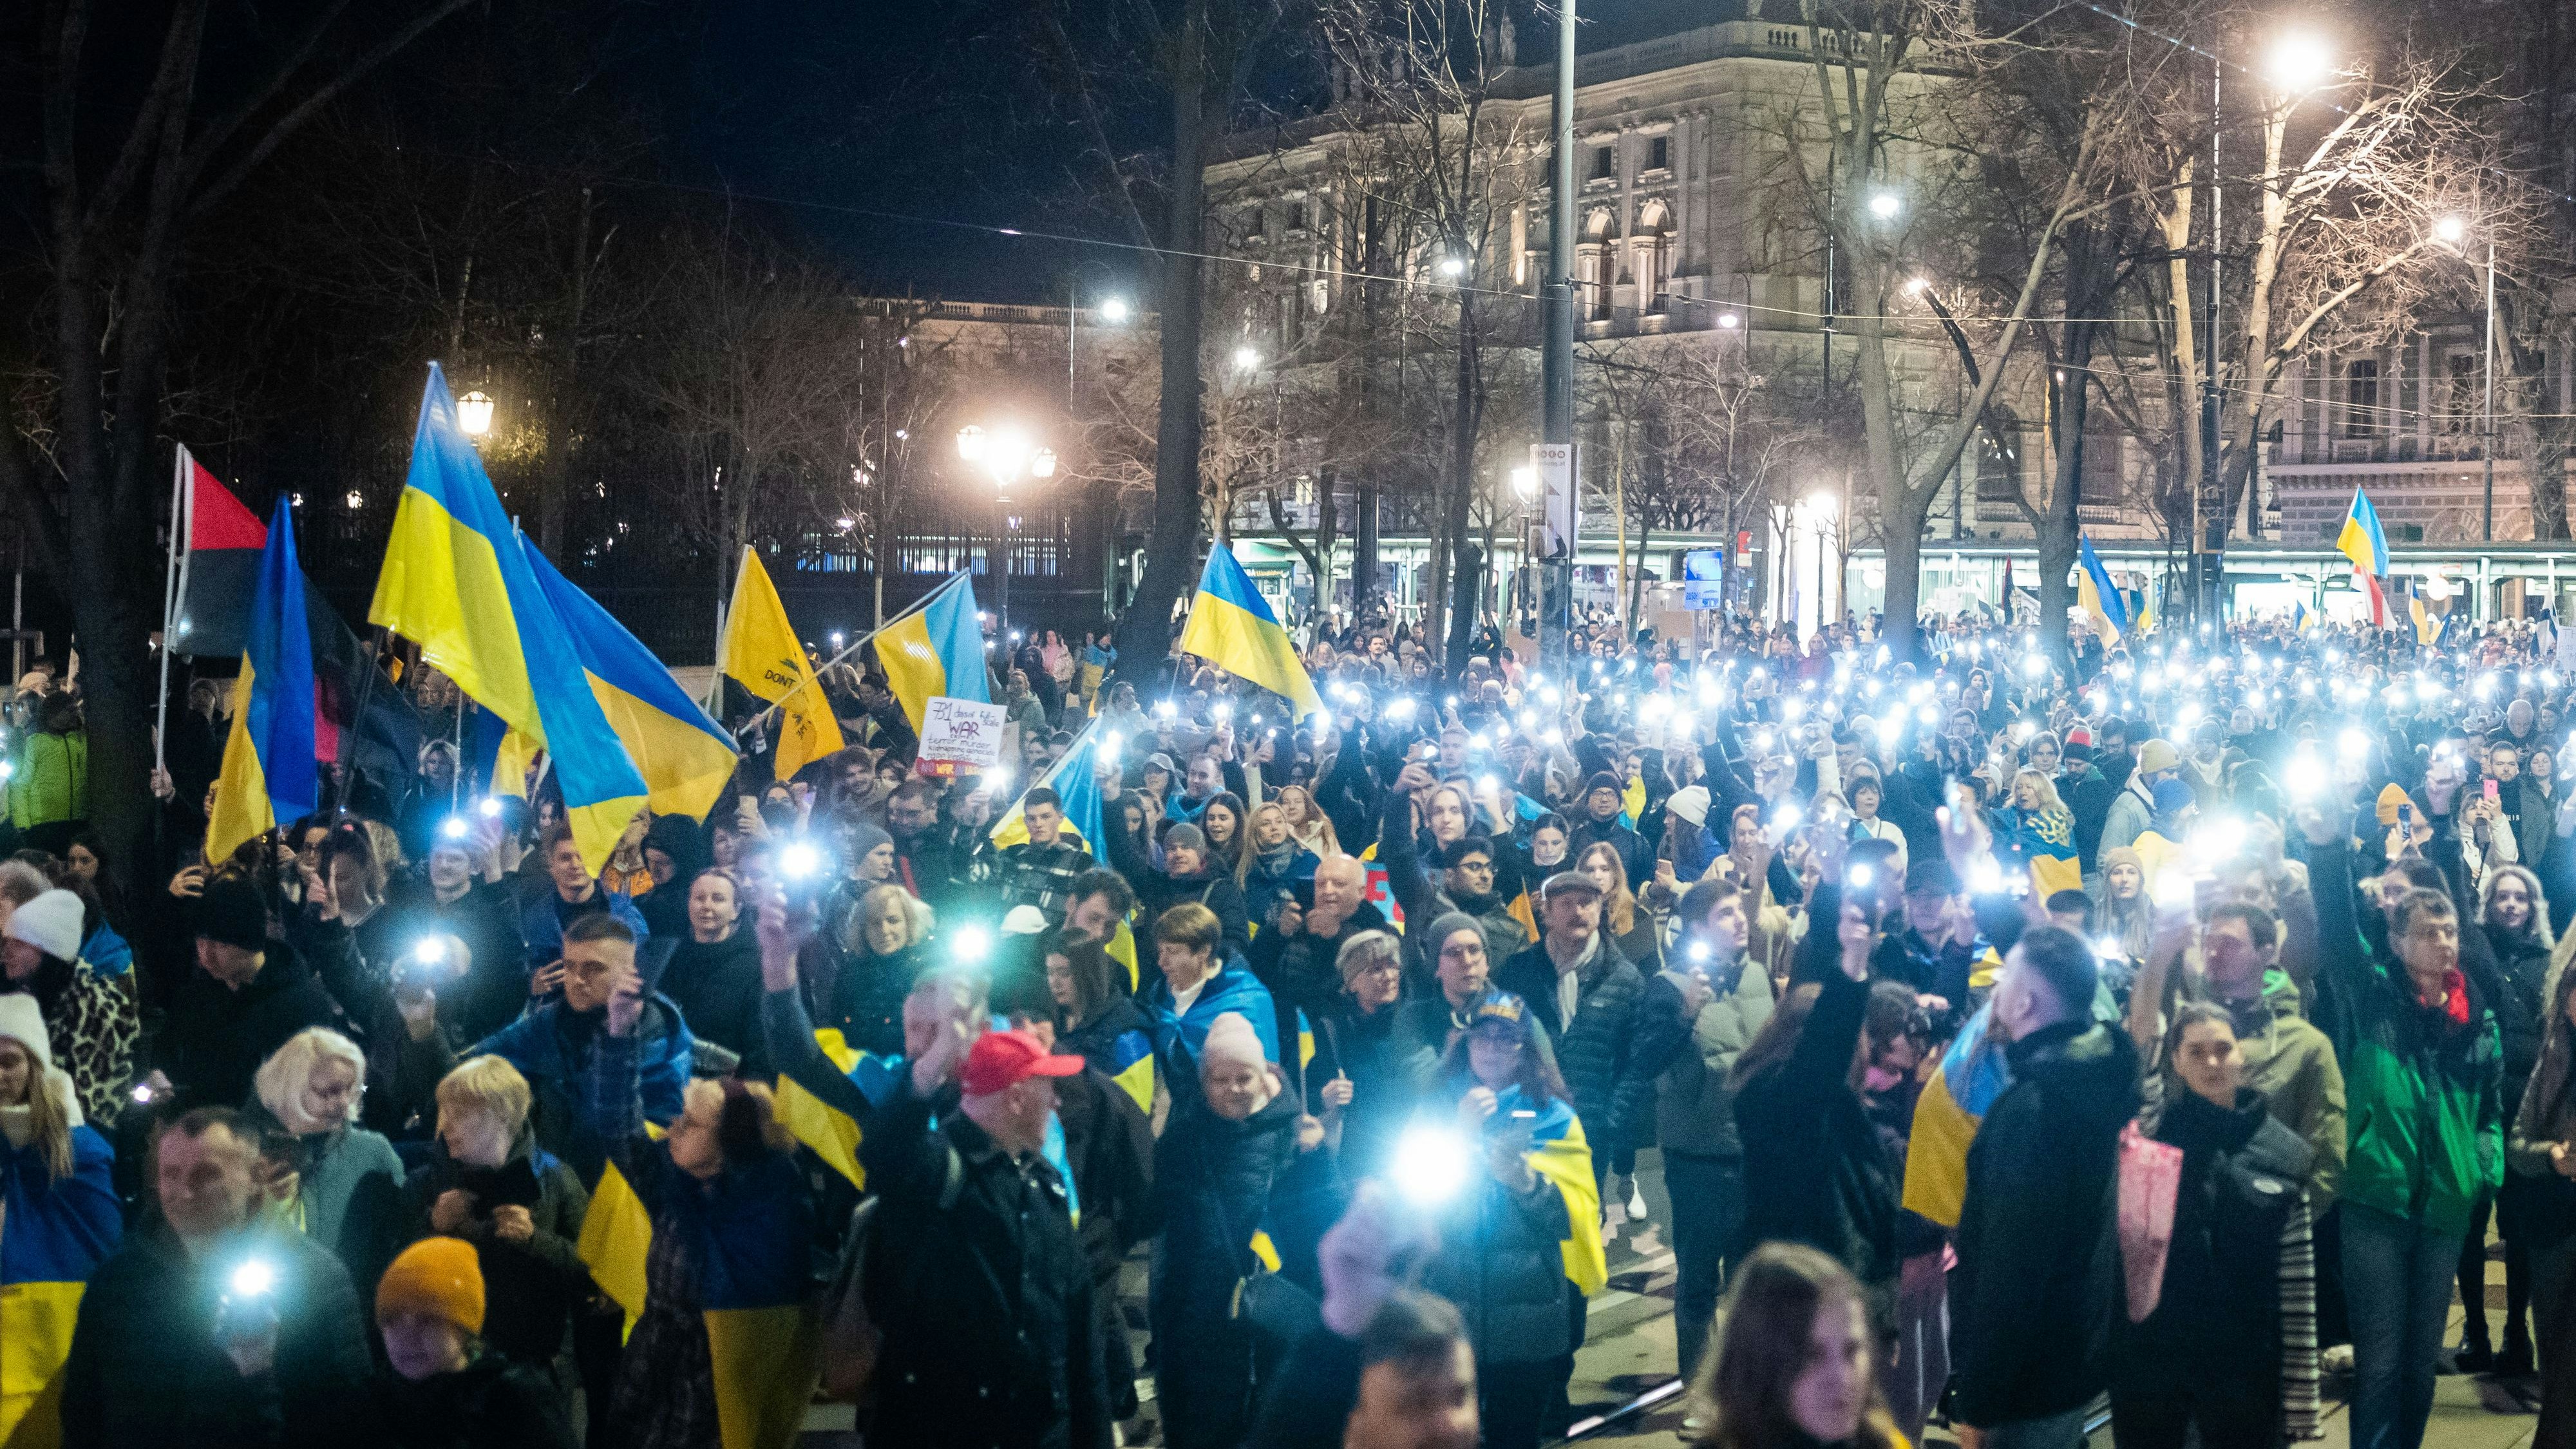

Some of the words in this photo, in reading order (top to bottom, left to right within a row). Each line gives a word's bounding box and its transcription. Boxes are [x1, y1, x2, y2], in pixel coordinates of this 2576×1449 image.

[764, 669, 796, 688] DONT
[949, 721, 980, 736] WAR
[960, 739, 991, 749] murder
